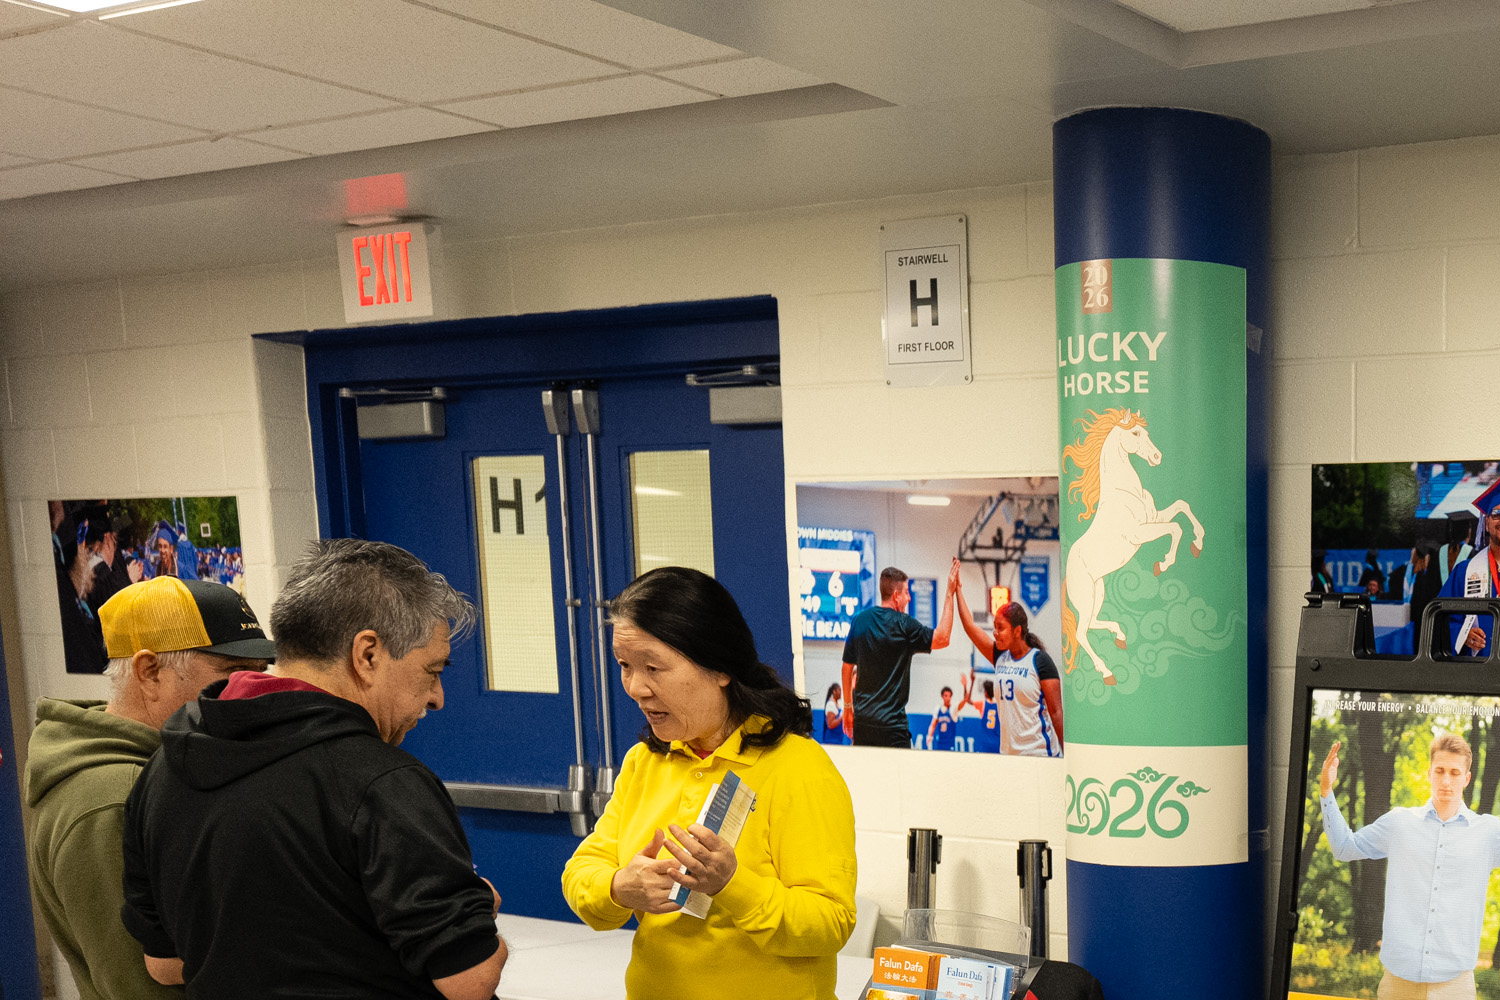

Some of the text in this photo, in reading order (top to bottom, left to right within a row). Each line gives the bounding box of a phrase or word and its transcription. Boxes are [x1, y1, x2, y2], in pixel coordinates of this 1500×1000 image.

[352, 231, 413, 307] EXIT
[898, 253, 948, 267] STAIRWELL
[1083, 265, 1108, 287] 20
[909, 278, 939, 327] H
[1084, 287, 1109, 308] 26
[898, 341, 954, 353] FIRST FLOOR
[1058, 331, 1167, 368] LUCKY
[1064, 371, 1149, 398] HORSE
[999, 679, 1014, 701] 13
[1358, 701, 1376, 712] YOUR
[1377, 702, 1404, 713] ENERGY
[1416, 703, 1446, 714] BALANCE
[1448, 704, 1469, 715] YOUR
[1065, 774, 1190, 840] 2026
[880, 957, 923, 973] Falun Dafa
[947, 967, 983, 981] Falun Dafa
